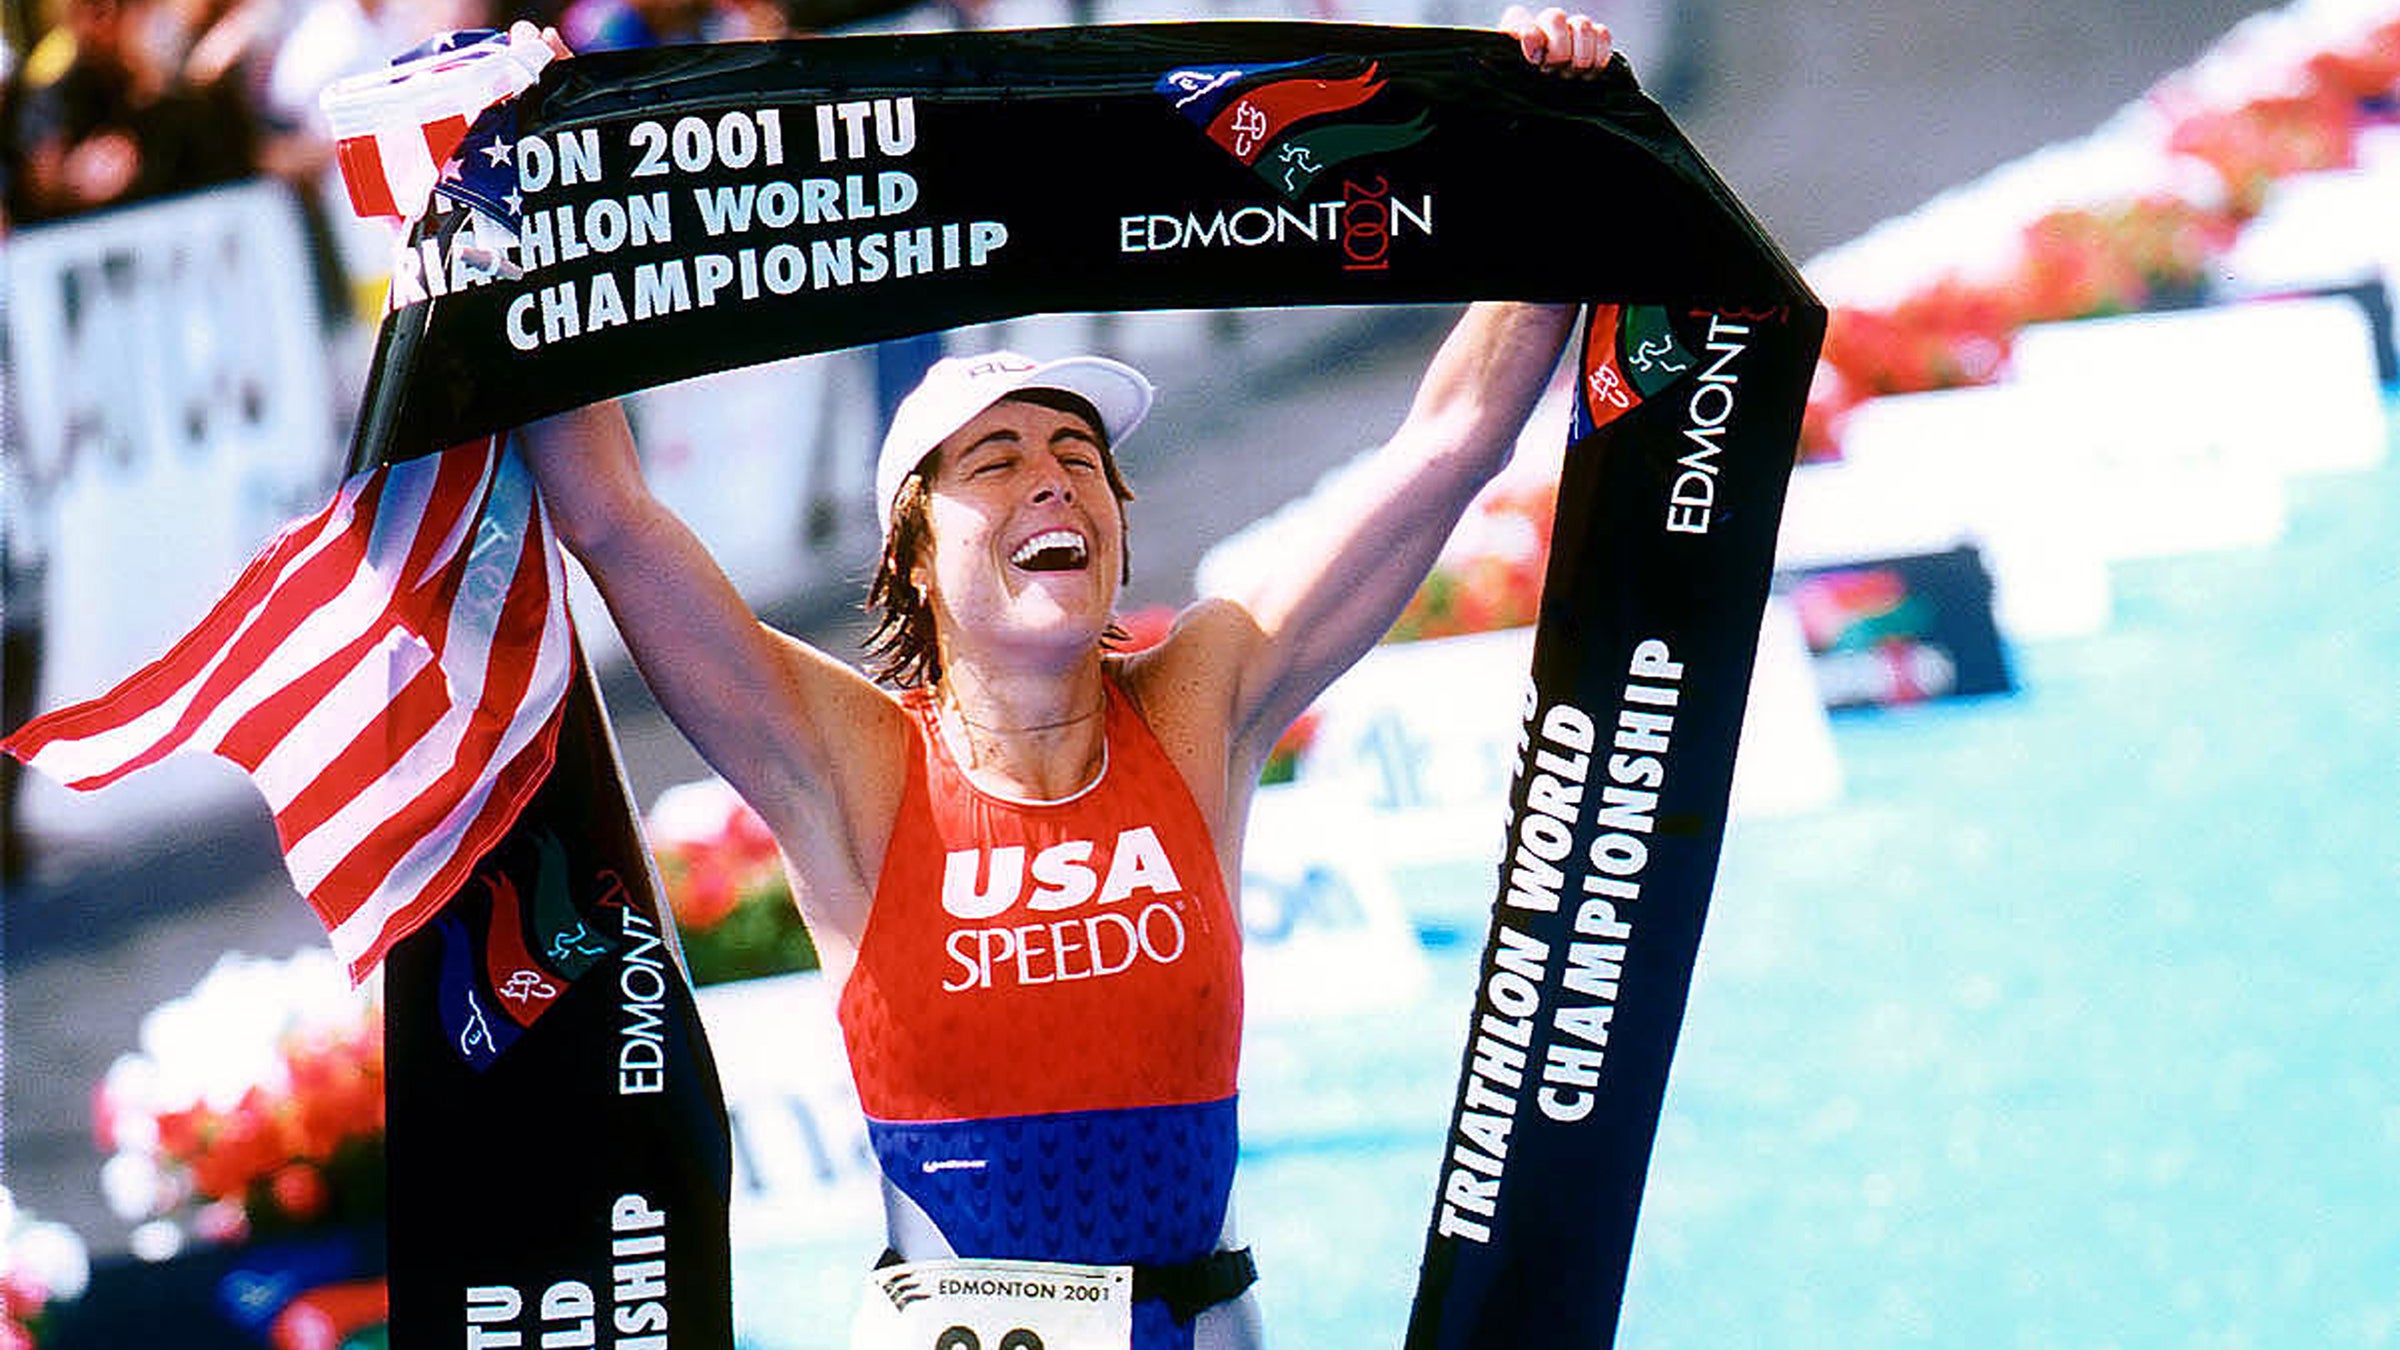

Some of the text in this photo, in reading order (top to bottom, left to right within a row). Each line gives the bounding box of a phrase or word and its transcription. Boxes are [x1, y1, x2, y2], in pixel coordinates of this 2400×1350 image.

[628, 108, 784, 179] 2001
[815, 97, 917, 162] ITU
[392, 171, 920, 311] RIAHLON WORLD
[505, 221, 1009, 352] CHAMPIONSHIP
[1342, 174, 1390, 271] 2001
[1666, 315, 1750, 534] EDMONT
[941, 826, 1182, 920] USA
[1536, 638, 1685, 1123] CHAMPIONSHIP
[618, 906, 666, 1095] EDMONT
[1438, 925, 1551, 1244] TRIATHLON
[1506, 704, 1596, 912] WORLD
[540, 1280, 596, 1350] LD
[939, 1280, 1109, 1301] EDMONTON 2001
